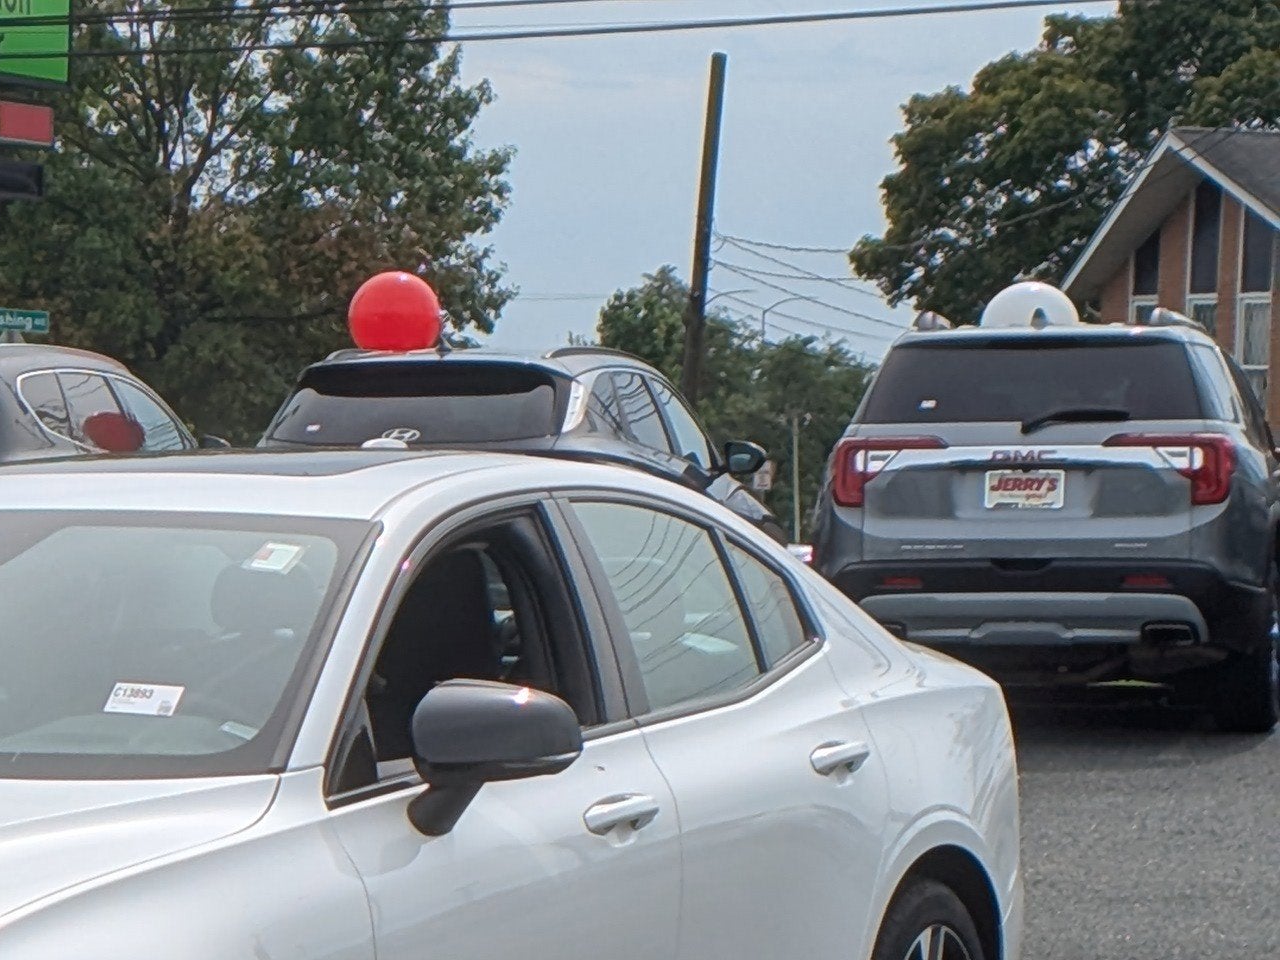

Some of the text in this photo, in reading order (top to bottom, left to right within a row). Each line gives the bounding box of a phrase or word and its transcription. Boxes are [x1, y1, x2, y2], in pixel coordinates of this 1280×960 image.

[989, 449, 1058, 461] GMC
[989, 477, 1058, 492] JERRY'S
[113, 687, 154, 699] C13893
